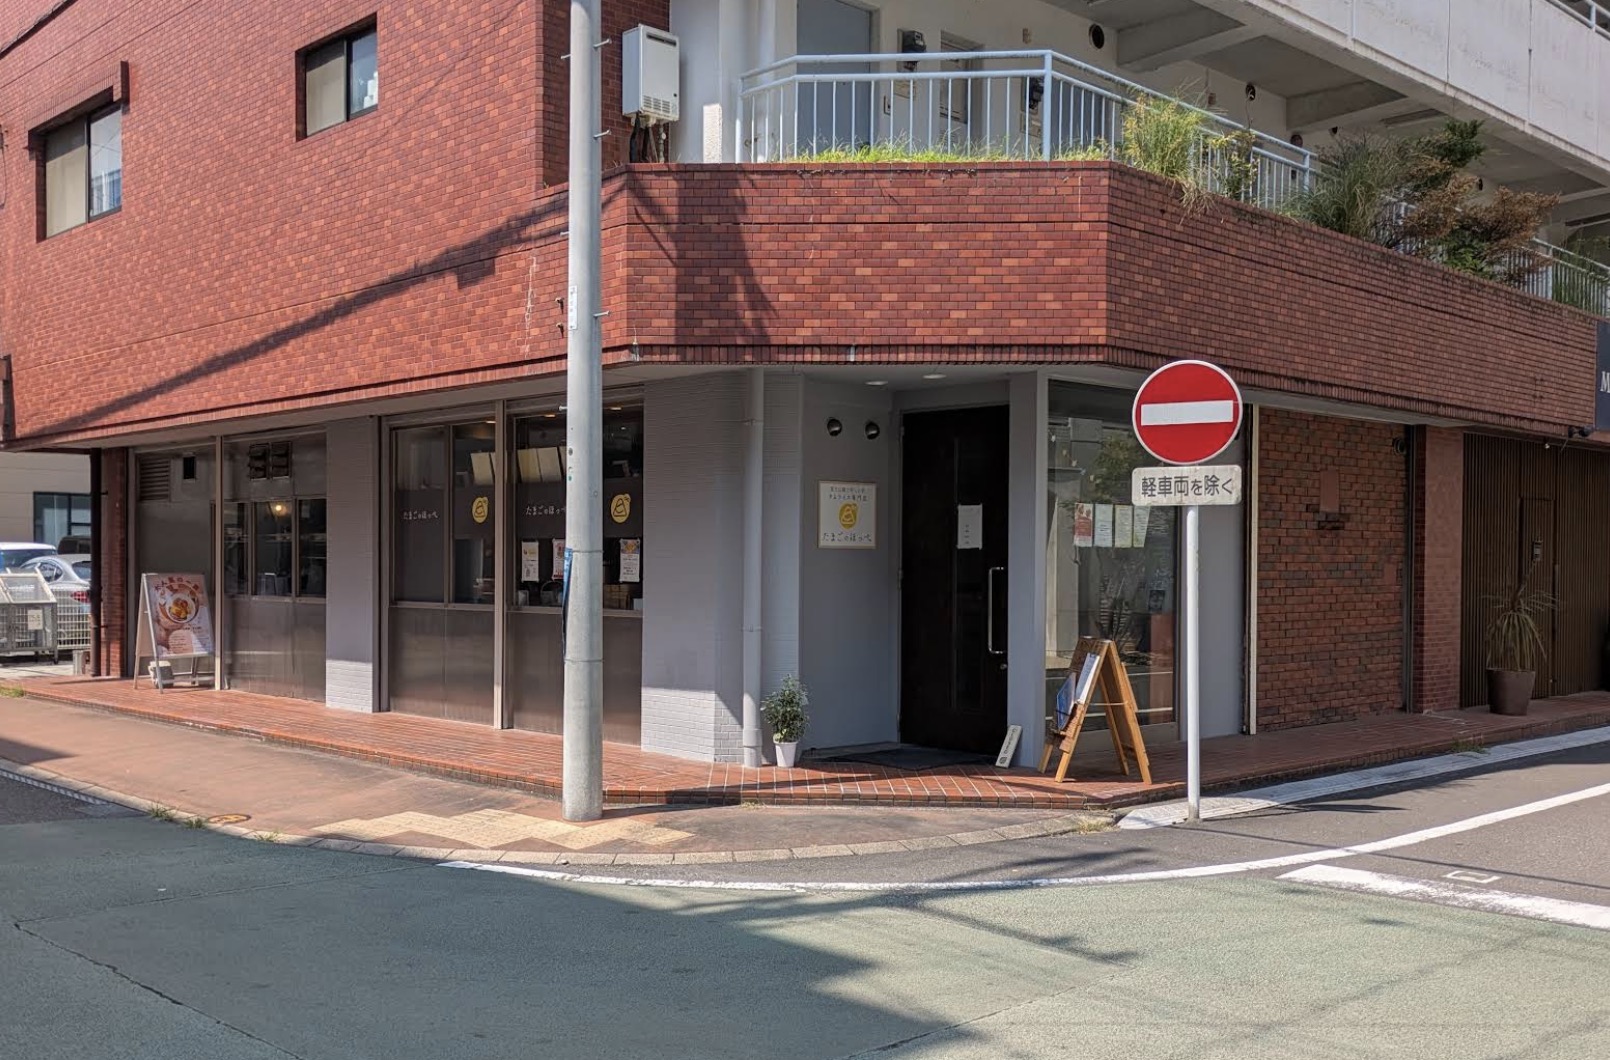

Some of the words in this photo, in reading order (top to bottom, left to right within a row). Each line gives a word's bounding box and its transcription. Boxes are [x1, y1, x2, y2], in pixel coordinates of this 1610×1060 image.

[1141, 474, 1232, 497] 軽車両を除く
